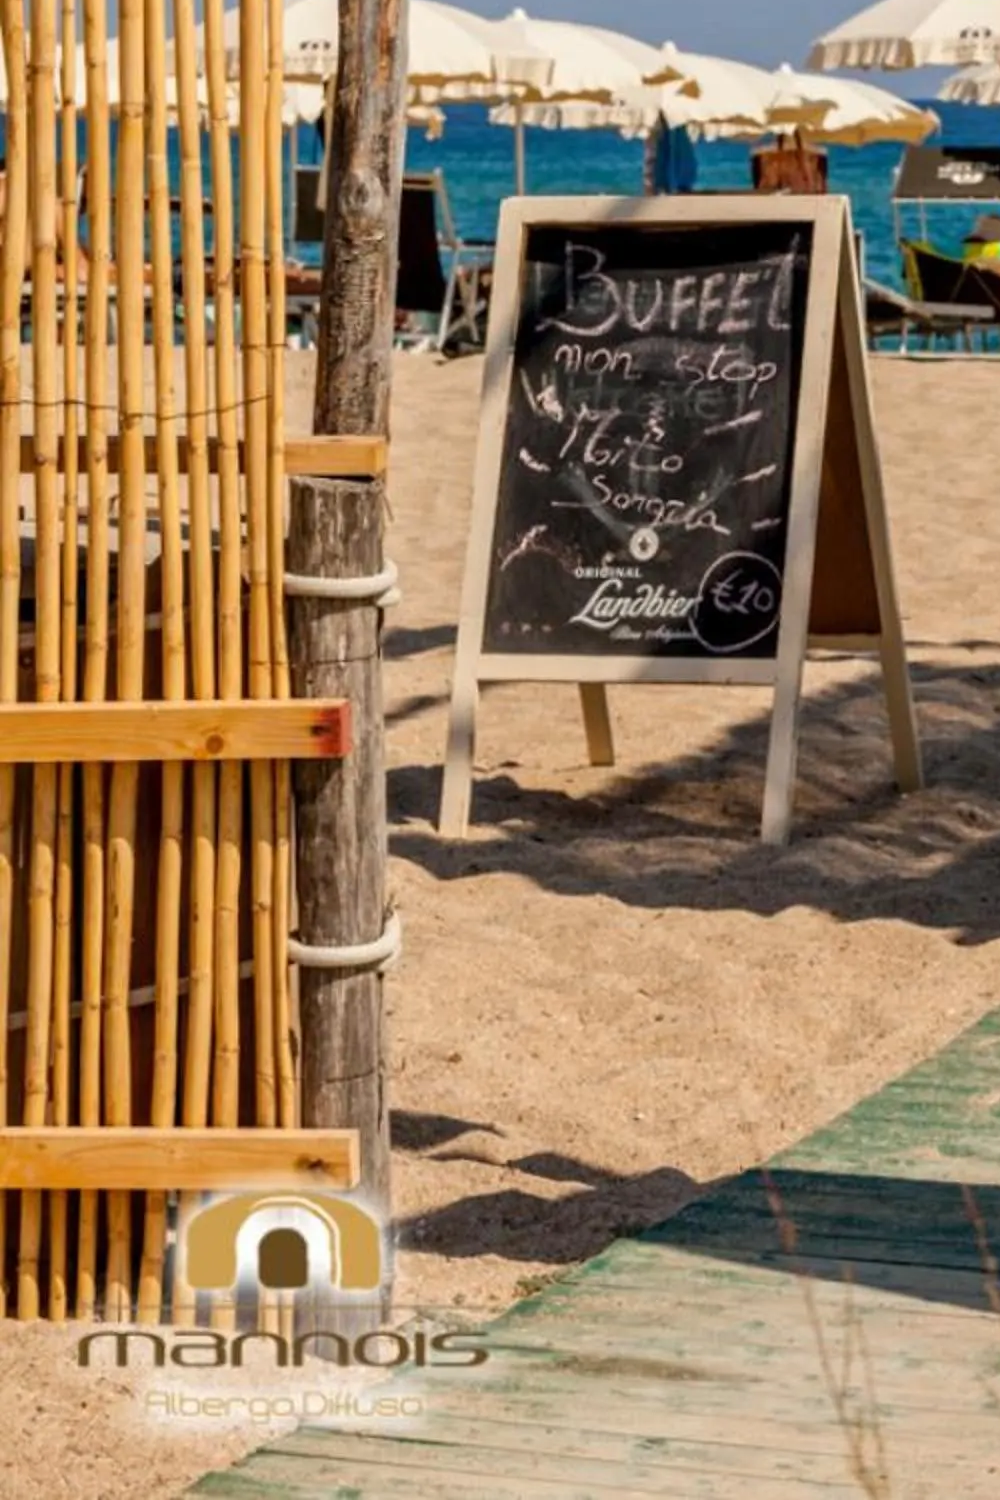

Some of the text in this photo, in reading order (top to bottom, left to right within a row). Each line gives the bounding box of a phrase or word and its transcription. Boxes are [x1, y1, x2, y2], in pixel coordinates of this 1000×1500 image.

[554, 343, 778, 400] non stop
[574, 567, 643, 579] ORIGINAL
[710, 568, 775, 614] €10
[569, 578, 702, 629] Landbier
